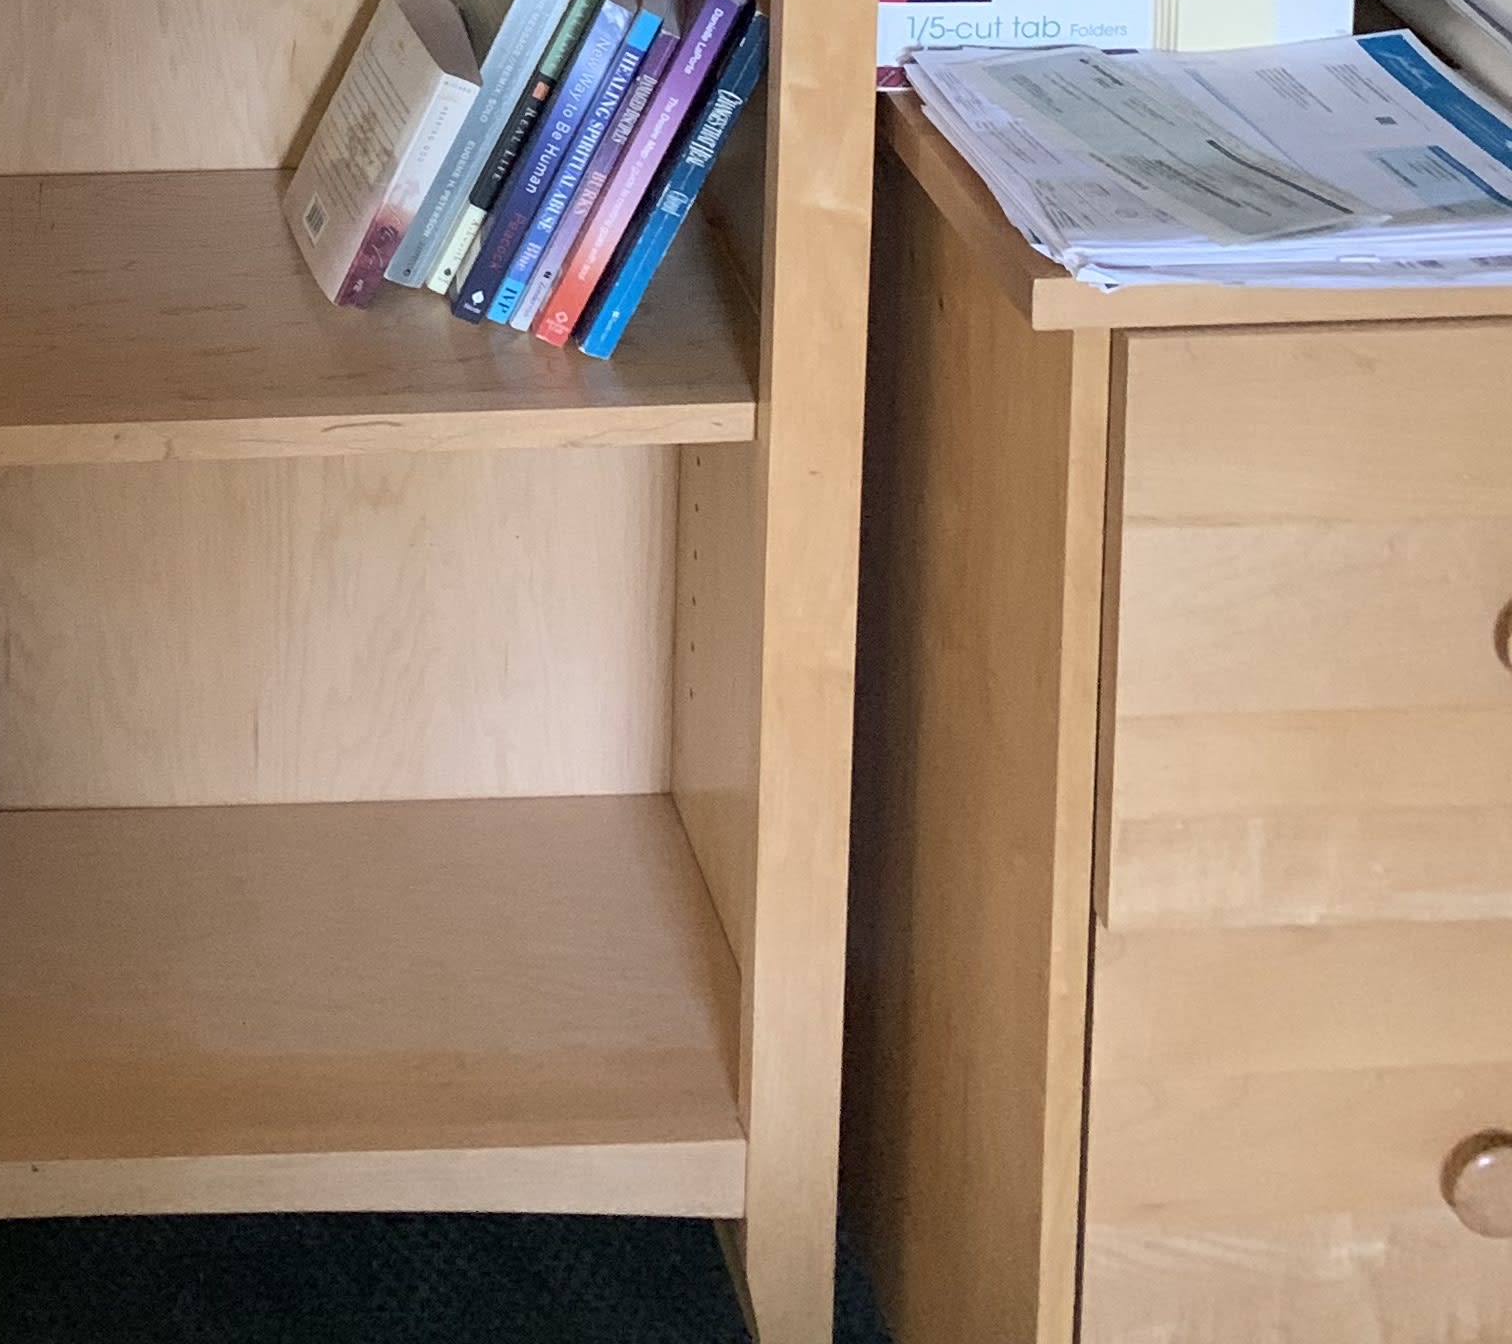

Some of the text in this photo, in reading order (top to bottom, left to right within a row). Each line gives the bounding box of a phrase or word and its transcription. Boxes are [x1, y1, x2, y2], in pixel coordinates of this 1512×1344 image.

[907, 16, 1127, 41] 1/5-cut tab Folders
[536, 52, 639, 231] HEALING SPIRITUAL ABUSE
[516, 241, 543, 271] Blue
